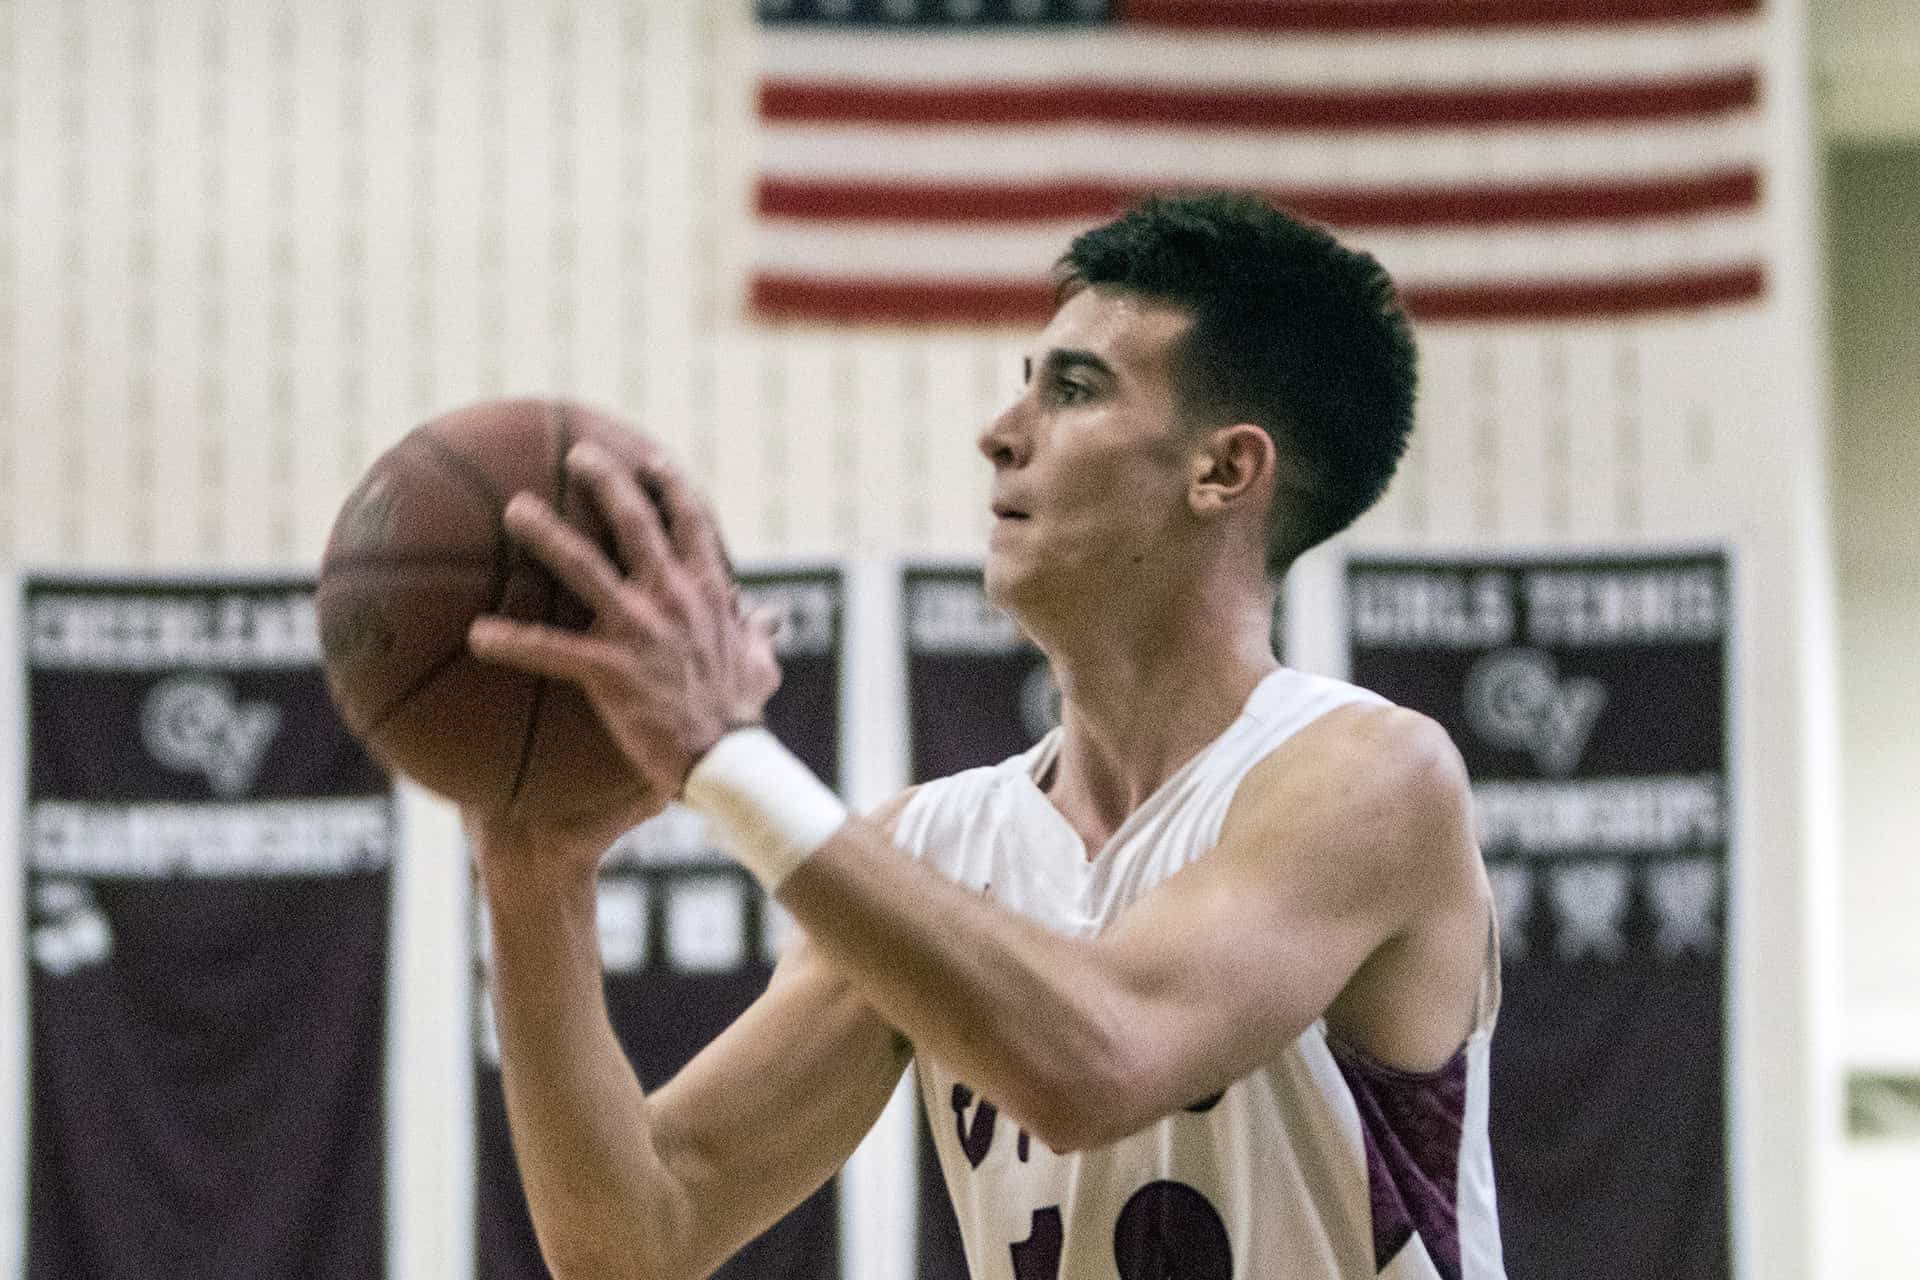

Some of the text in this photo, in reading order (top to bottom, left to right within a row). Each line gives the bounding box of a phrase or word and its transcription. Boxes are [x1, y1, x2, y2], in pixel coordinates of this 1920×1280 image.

[1355, 568, 1716, 646] GIRLS TENNIS
[34, 801, 387, 876] CHAMPIONSHIPS
